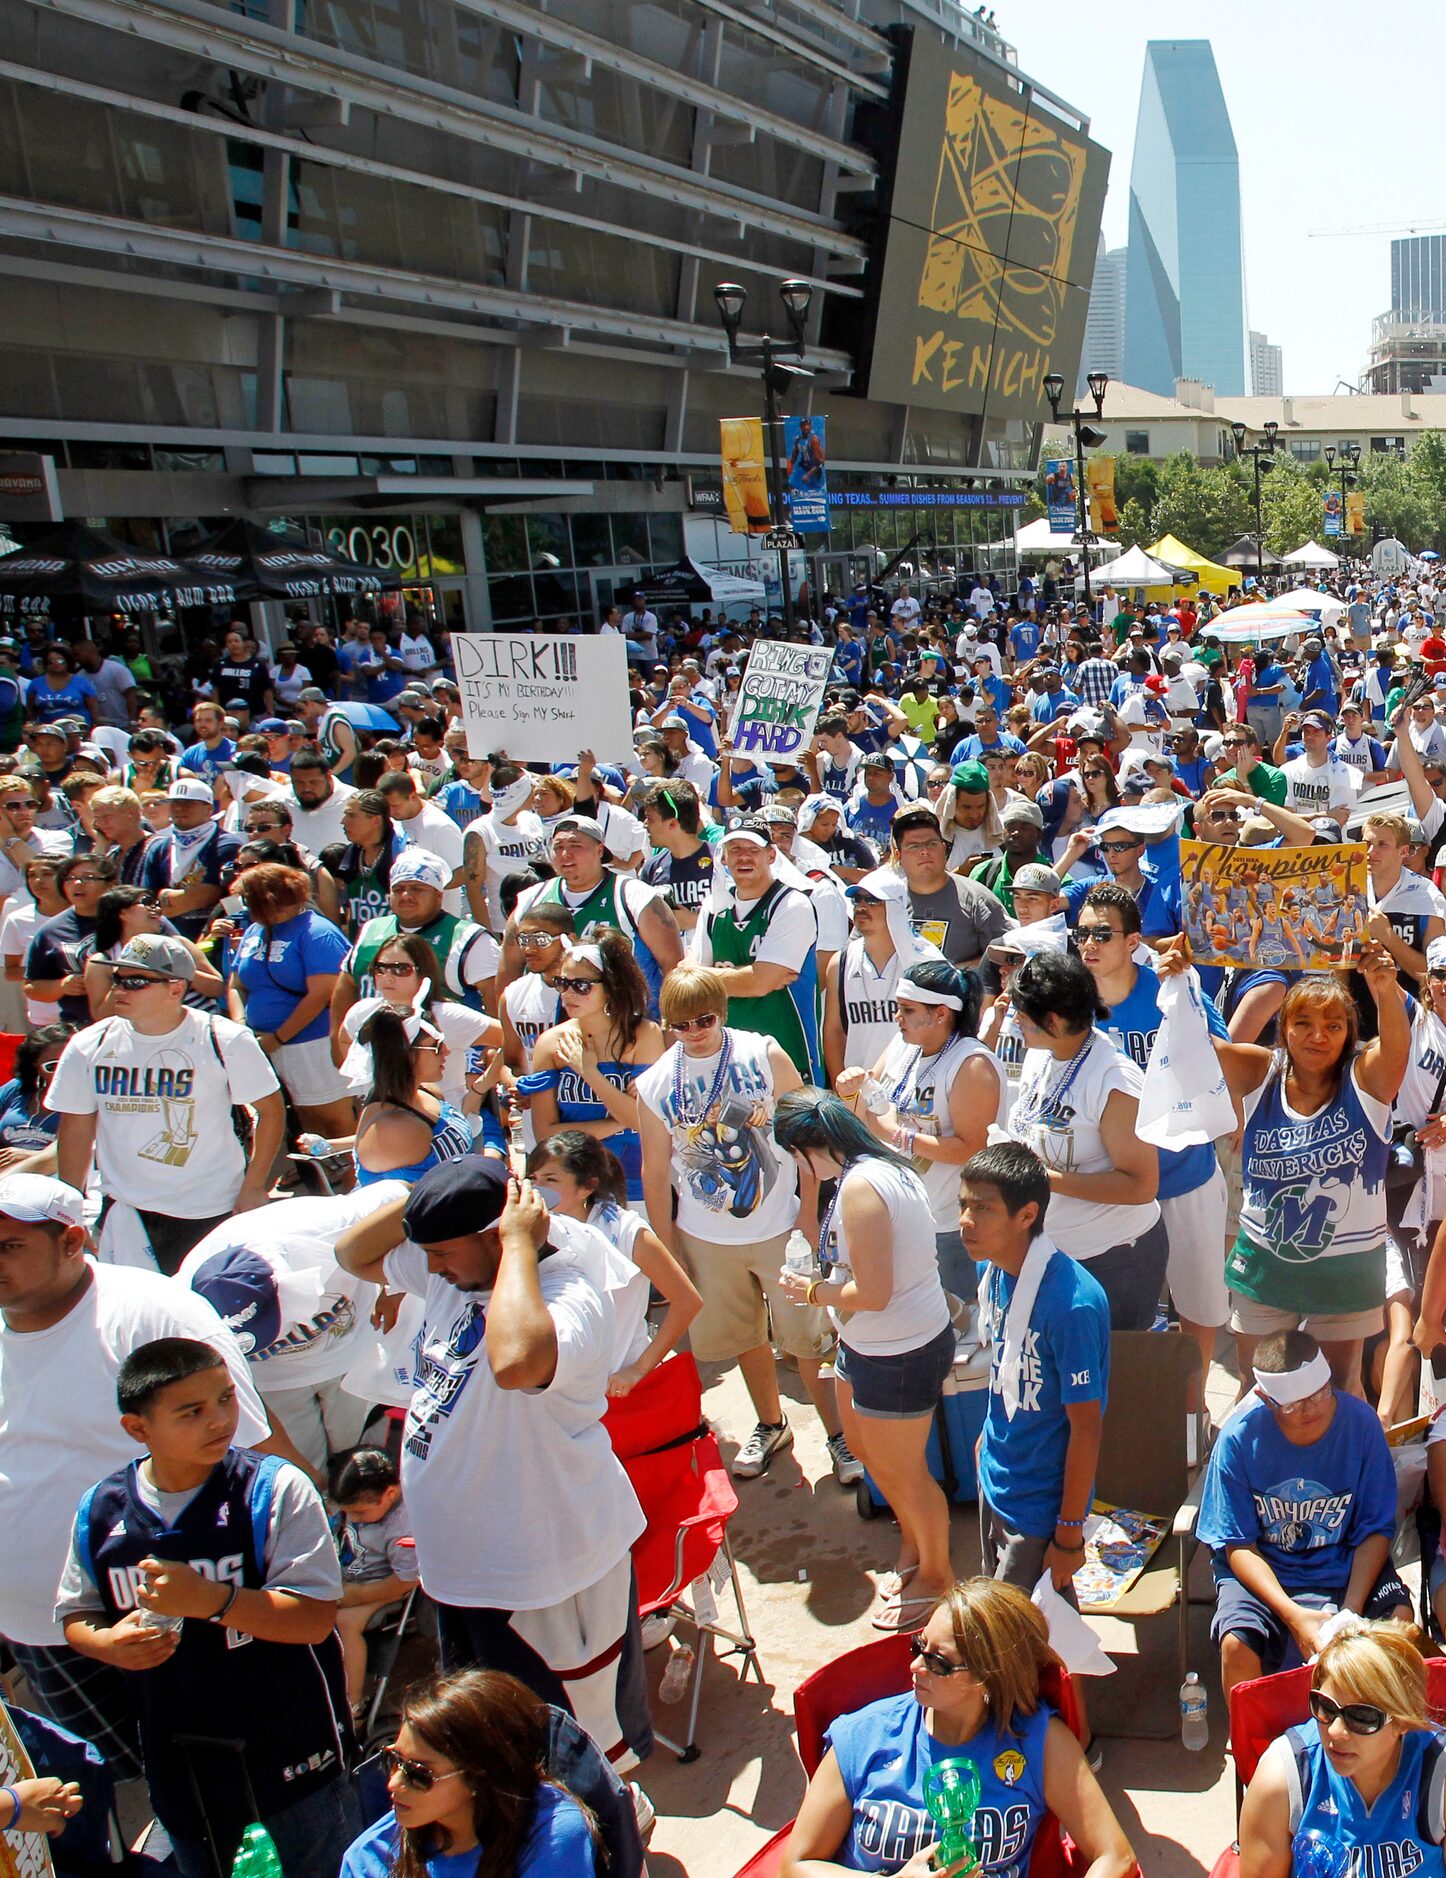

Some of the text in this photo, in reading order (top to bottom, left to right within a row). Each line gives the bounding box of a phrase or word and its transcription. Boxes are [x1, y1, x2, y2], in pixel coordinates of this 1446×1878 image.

[911, 330, 1050, 408] KENICHI
[880, 494, 910, 505] SUMMER
[911, 494, 936, 505] DISHES
[328, 526, 414, 569] 3030
[767, 541, 792, 549] PLAZA
[90, 558, 179, 575] HAVANA
[175, 587, 204, 607] RUM
[208, 585, 236, 602] BAR
[456, 636, 578, 682] DIRK!!!
[750, 641, 809, 675] RING
[466, 680, 490, 699] IT'S
[499, 681, 512, 698] MY
[743, 673, 820, 704] GOT MY
[468, 701, 576, 723] Please Sign MY Shirt
[739, 694, 816, 729] DIRK
[733, 719, 803, 753] HARD
[1338, 754, 1367, 765] DALLAS
[1293, 781, 1330, 802] DALLAS
[1200, 842, 1346, 881] Champions
[671, 877, 711, 904] LLAS
[849, 1000, 899, 1024] DALLA
[95, 1065, 195, 1098] DALLAS
[105, 1101, 161, 1113] CHAMPIONS
[1254, 1109, 1350, 1153] DALLAS
[1265, 1195, 1337, 1248] M
[1252, 1493, 1352, 1529] PLAYOFFS
[109, 1553, 244, 1610] DAAS
[1316, 1804, 1338, 1815] adidas
[858, 1799, 1031, 1863] DALAS
